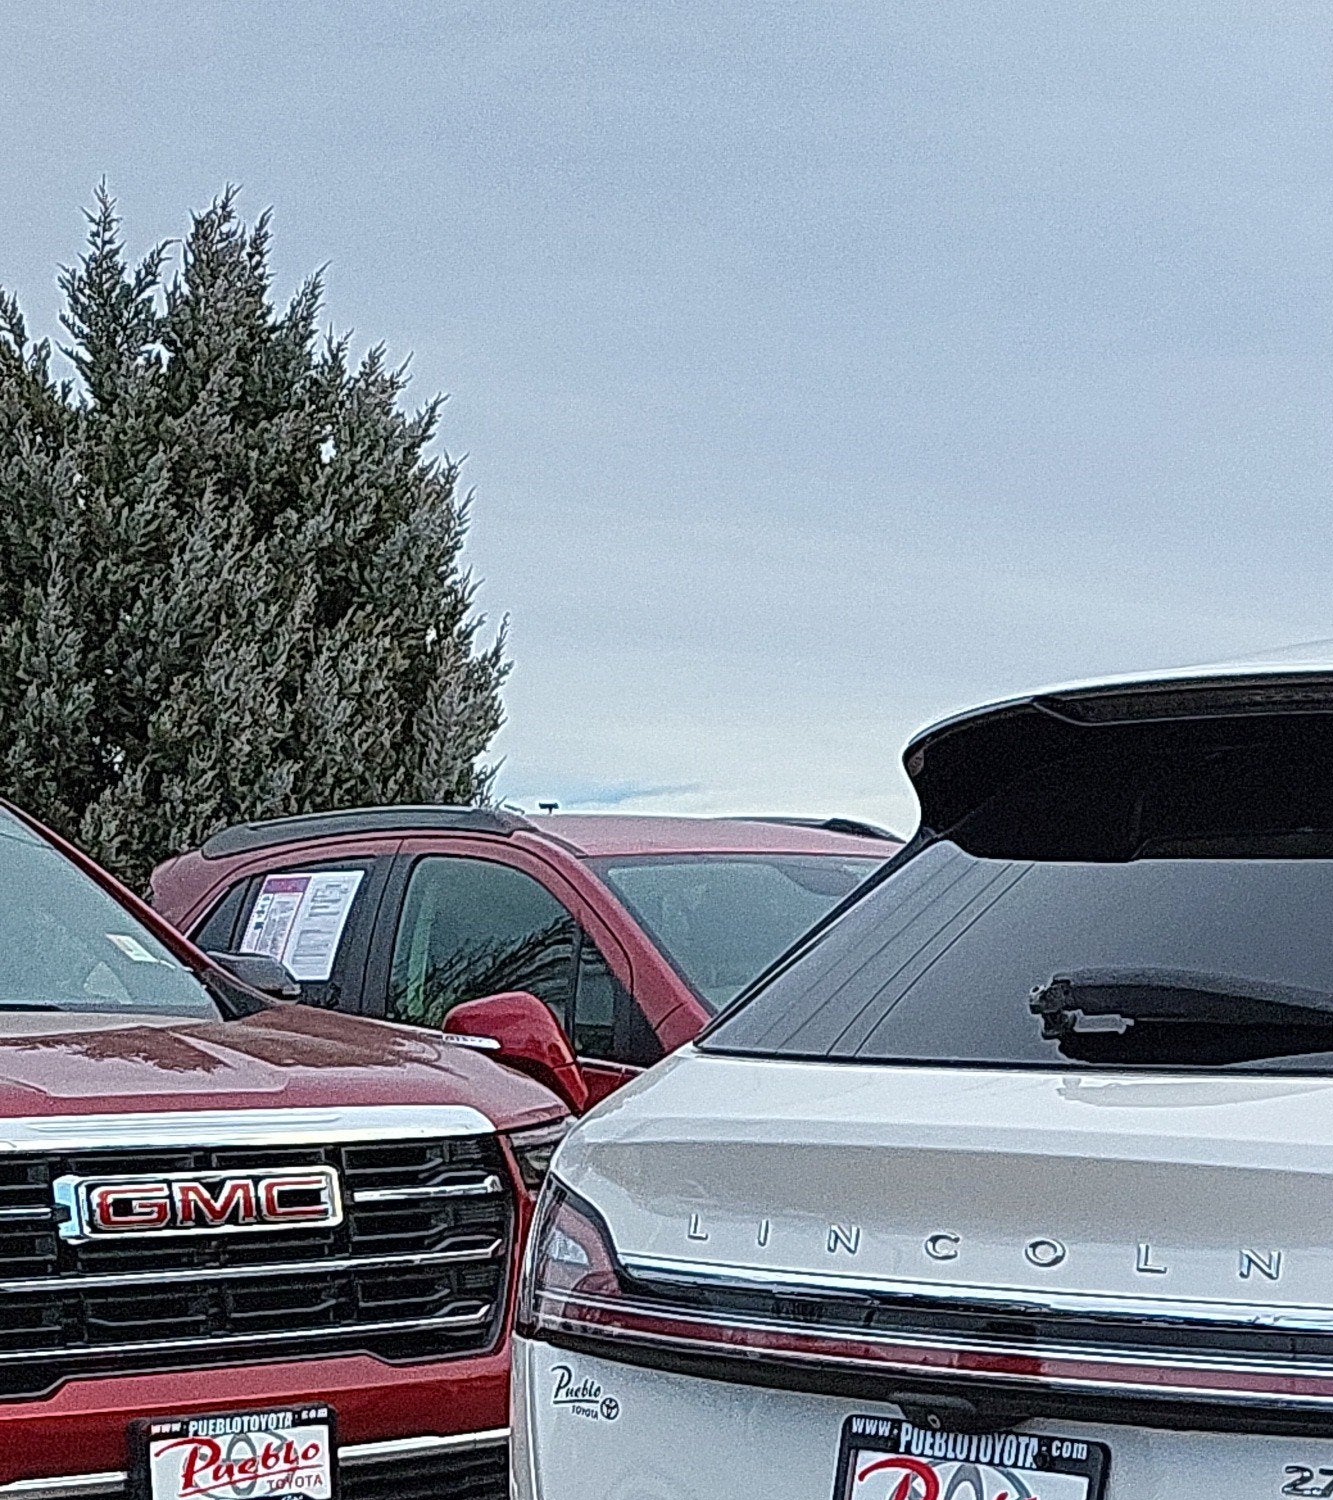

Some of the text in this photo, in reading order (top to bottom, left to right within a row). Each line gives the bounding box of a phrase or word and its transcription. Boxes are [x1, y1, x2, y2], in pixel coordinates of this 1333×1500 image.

[97, 1174, 329, 1229] GMC
[687, 1213, 1283, 1281] LINCOLN
[551, 1365, 601, 1399] Pueblo
[571, 1405, 599, 1420] TOYOTA
[154, 1437, 321, 1491] Pueblo
[266, 1473, 323, 1492] TOYOTA
